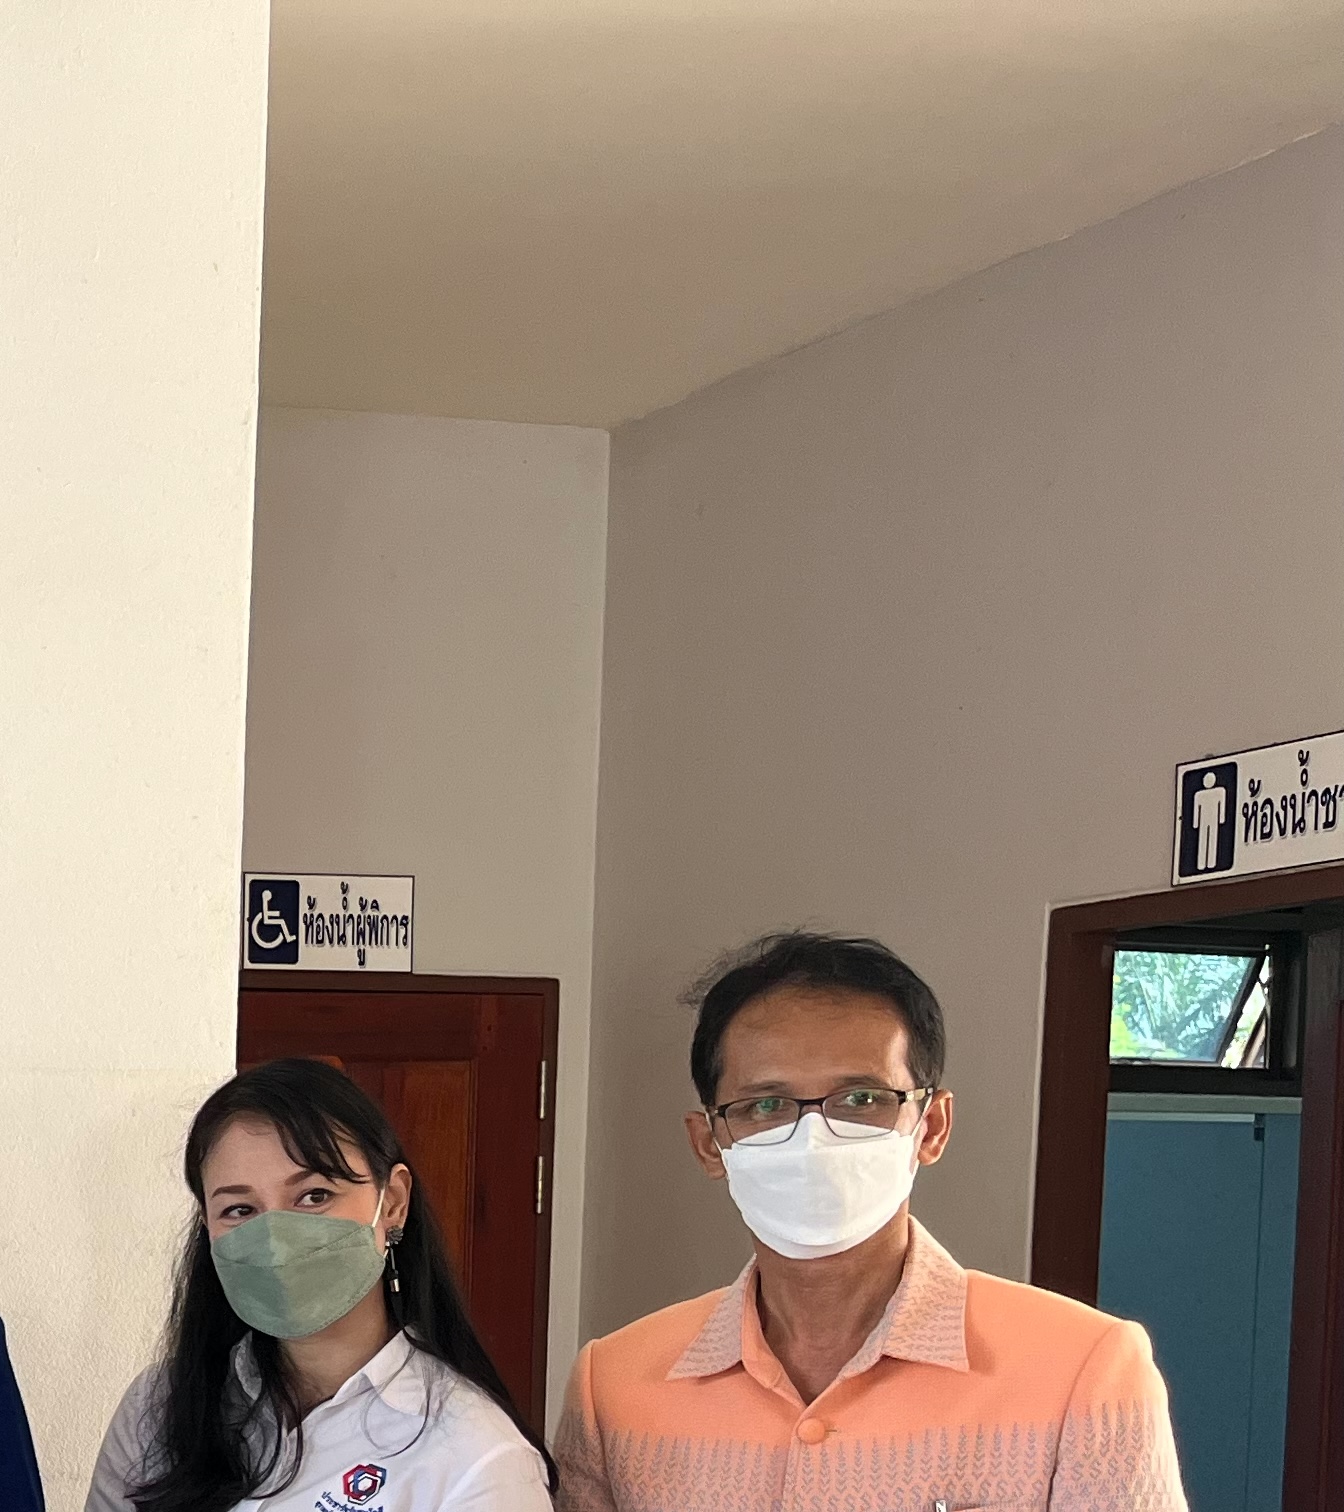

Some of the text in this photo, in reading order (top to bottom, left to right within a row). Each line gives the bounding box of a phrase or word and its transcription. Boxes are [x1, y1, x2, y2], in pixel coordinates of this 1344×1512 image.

[302, 881, 410, 967] ห้องน้ำผู้พิการ
